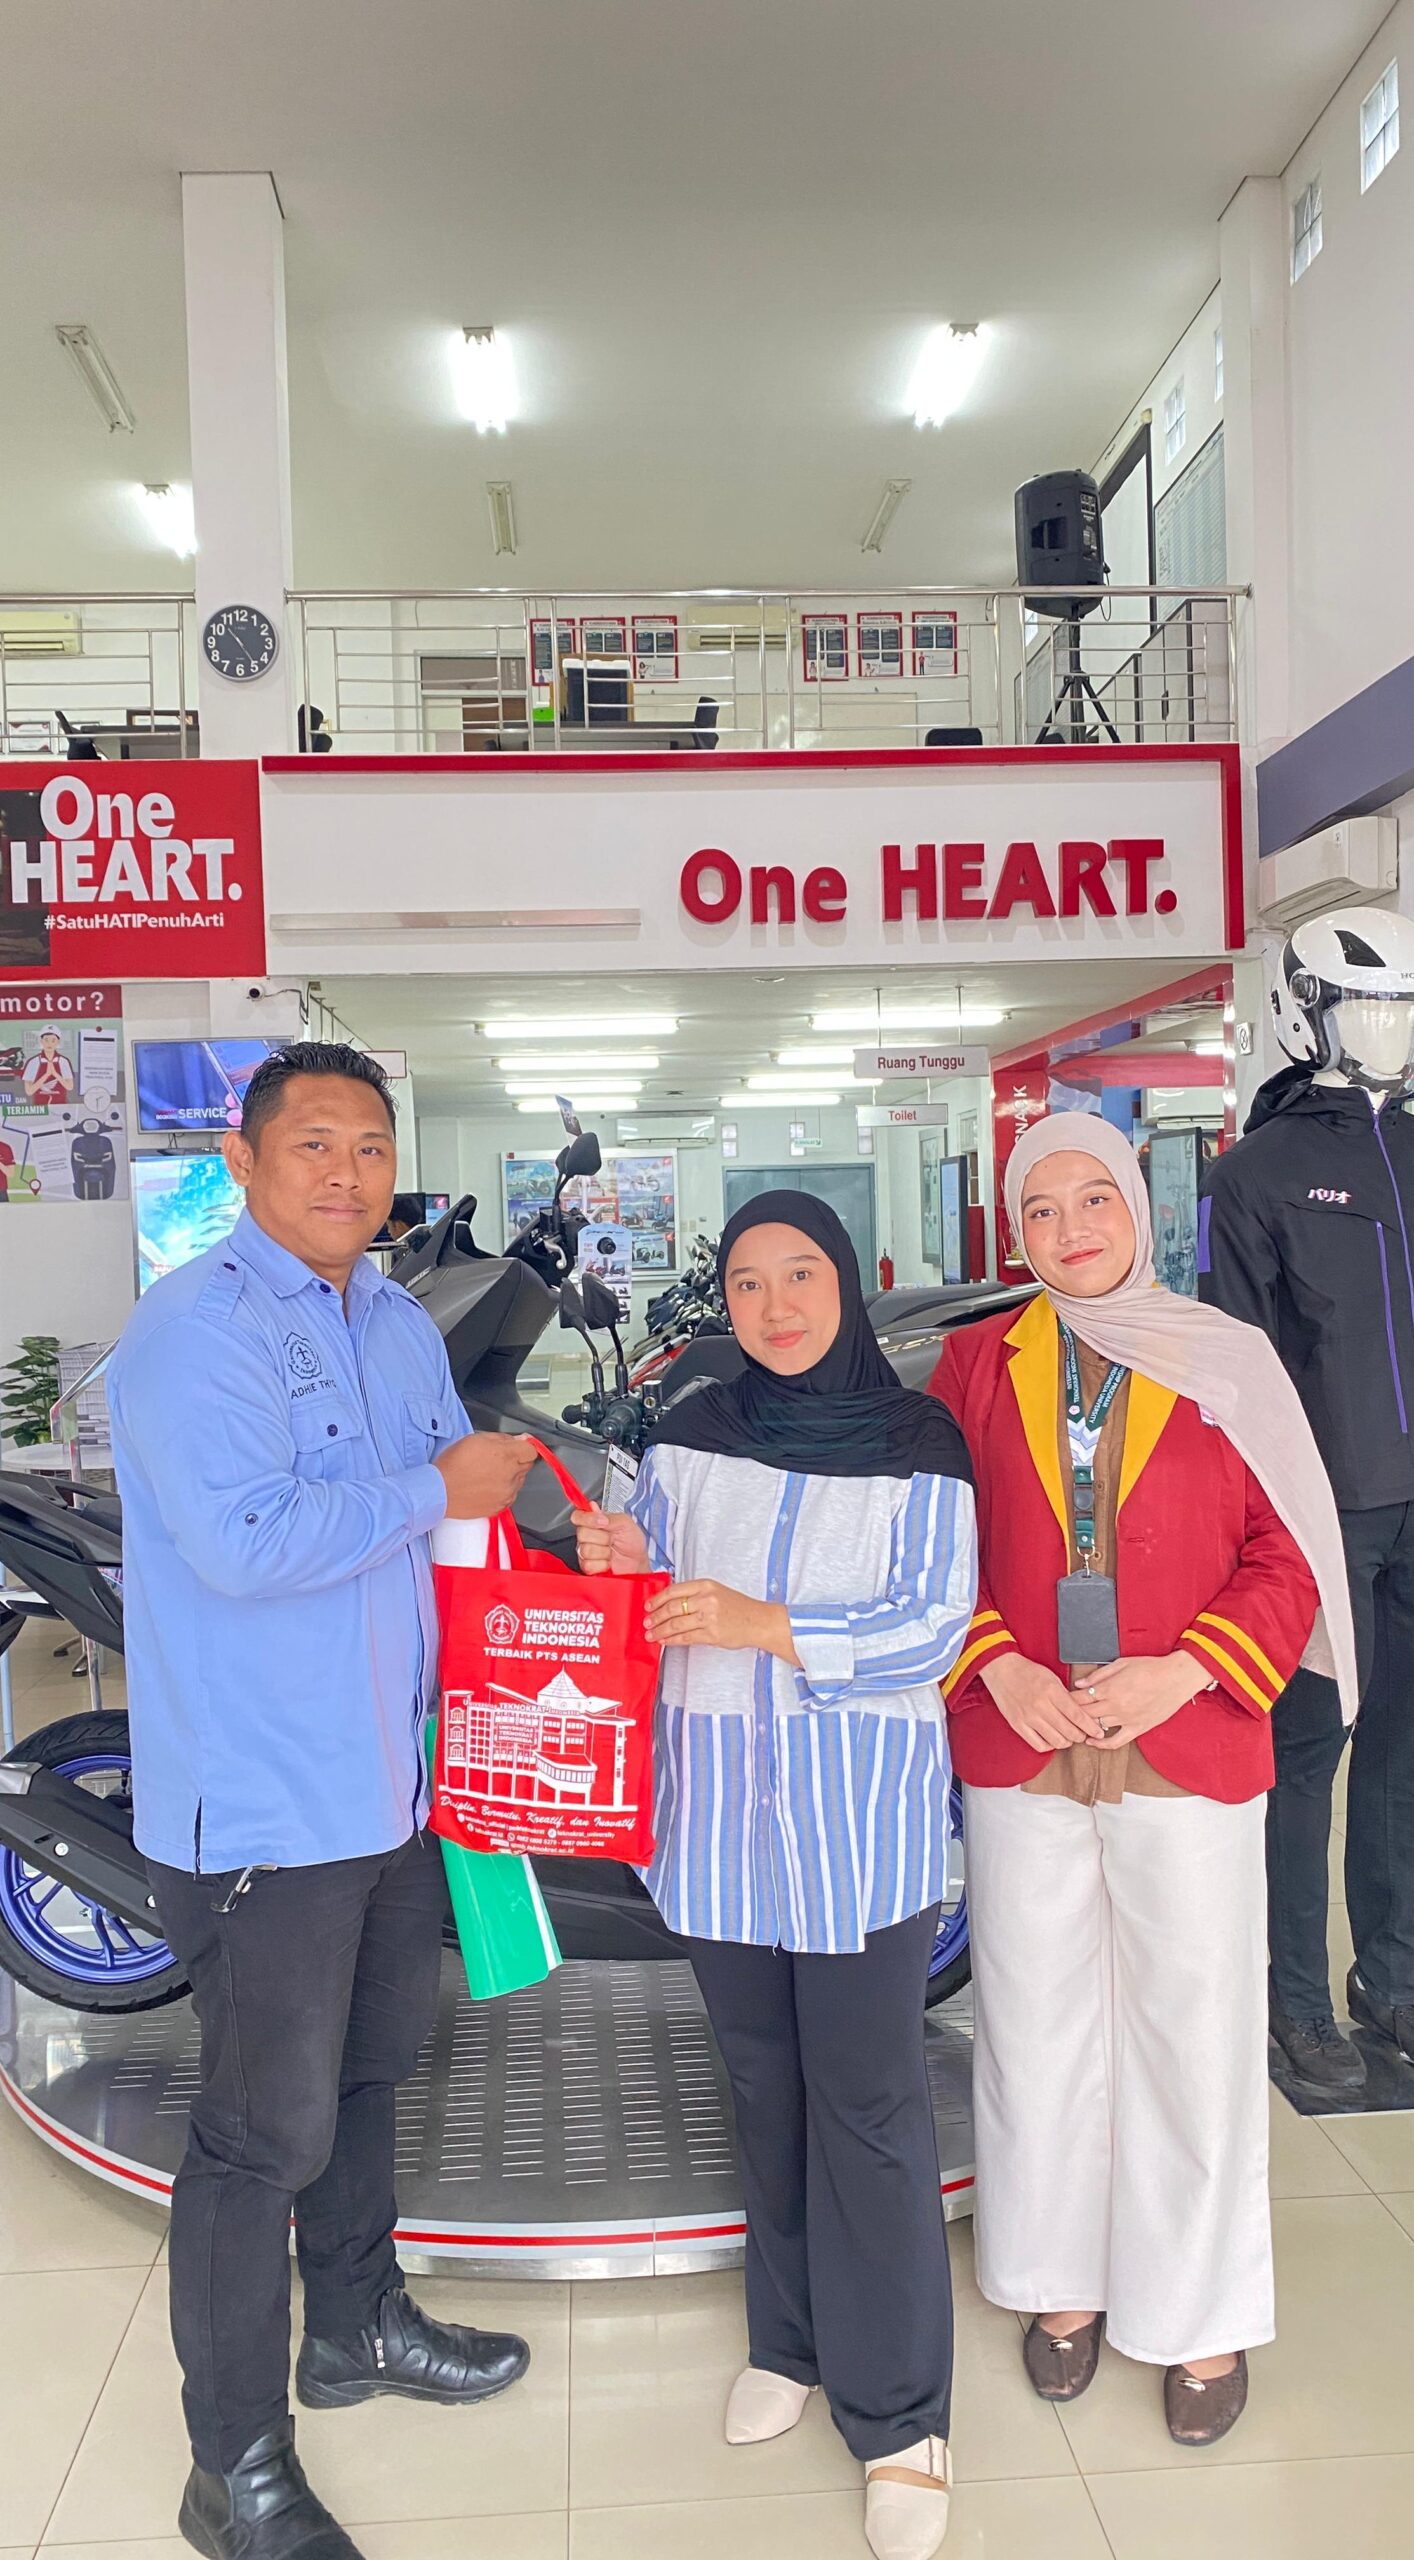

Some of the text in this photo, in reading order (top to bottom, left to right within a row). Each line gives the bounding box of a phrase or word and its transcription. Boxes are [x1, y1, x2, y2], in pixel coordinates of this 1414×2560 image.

[221, 612, 232, 625] 11
[234, 609, 248, 622] 12
[251, 614, 257, 626] 1
[210, 623, 225, 636] 10
[260, 624, 269, 636] 2
[207, 636, 216, 648] 9
[264, 638, 273, 650] 3
[211, 650, 220, 662] 8
[260, 652, 269, 664] 4
[221, 660, 230, 672] 7
[236, 664, 244, 676] 6
[250, 660, 258, 672] 5
[40, 775, 175, 840] One
[10, 837, 242, 903] HEART.
[680, 839, 1177, 925] One HEART.
[43, 911, 225, 932] #SatuHATIPenuhArti
[0, 991, 104, 1013] motor?
[877, 1055, 965, 1071] Ruang Tunggu
[0, 1093, 12, 1103] TU
[7, 1105, 45, 1116] TERJAMIN
[178, 1107, 227, 1119] SERVICE
[888, 1110, 917, 1121] Toilet
[524, 1608, 604, 1623] UNIVERSITAS
[523, 1620, 603, 1636] TEKNOKRAT
[522, 1632, 600, 1648] INDONESIA
[483, 1646, 600, 1664] TERBAIK PTS ASEAN
[499, 1702, 547, 1713] TEKNOKRAT
[569, 1817, 589, 1827] dan
